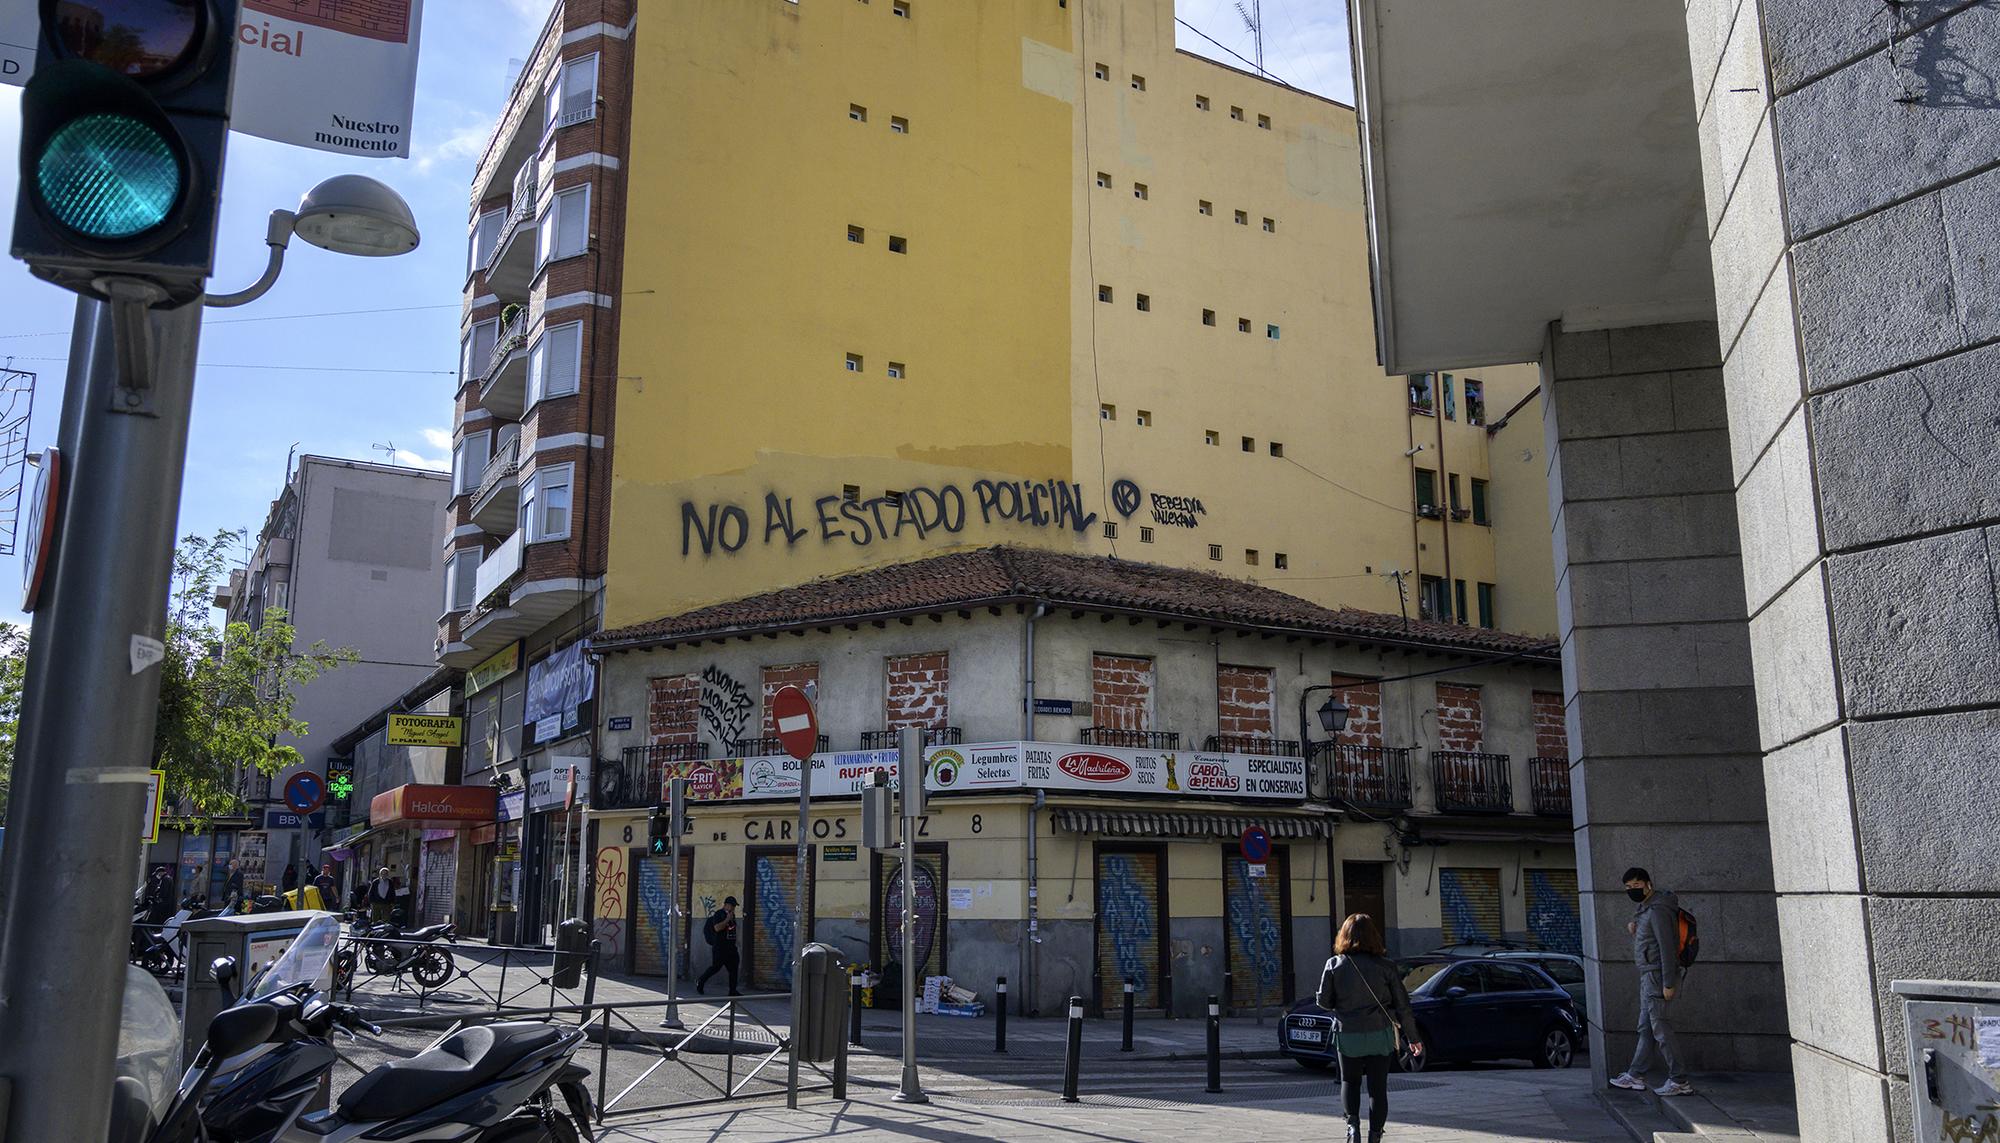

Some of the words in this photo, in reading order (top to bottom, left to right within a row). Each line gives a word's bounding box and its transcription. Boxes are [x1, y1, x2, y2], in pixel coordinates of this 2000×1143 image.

[331, 114, 399, 135] Nuestro
[314, 131, 398, 152] momento
[682, 501, 749, 556] NO
[764, 491, 808, 544] AL
[815, 484, 965, 546] ESTADO
[971, 753, 1018, 766] Legumbres
[1025, 750, 1052, 764] PATATAS
[1135, 756, 1157, 770] FRUTOS
[977, 767, 1011, 779] Selectas
[1028, 766, 1050, 779] FRITAS
[1190, 764, 1220, 777] CABO
[1248, 759, 1303, 775] ESPECIALISTAS
[693, 772, 714, 784] FRIT
[1137, 772, 1155, 784] SECOS
[1245, 779, 1257, 792] EN
[1258, 780, 1304, 794] CONSERVAS
[713, 832, 727, 841] DE
[744, 818, 847, 840] CAROS
[971, 814, 982, 834] 8
[623, 825, 633, 843] 8
